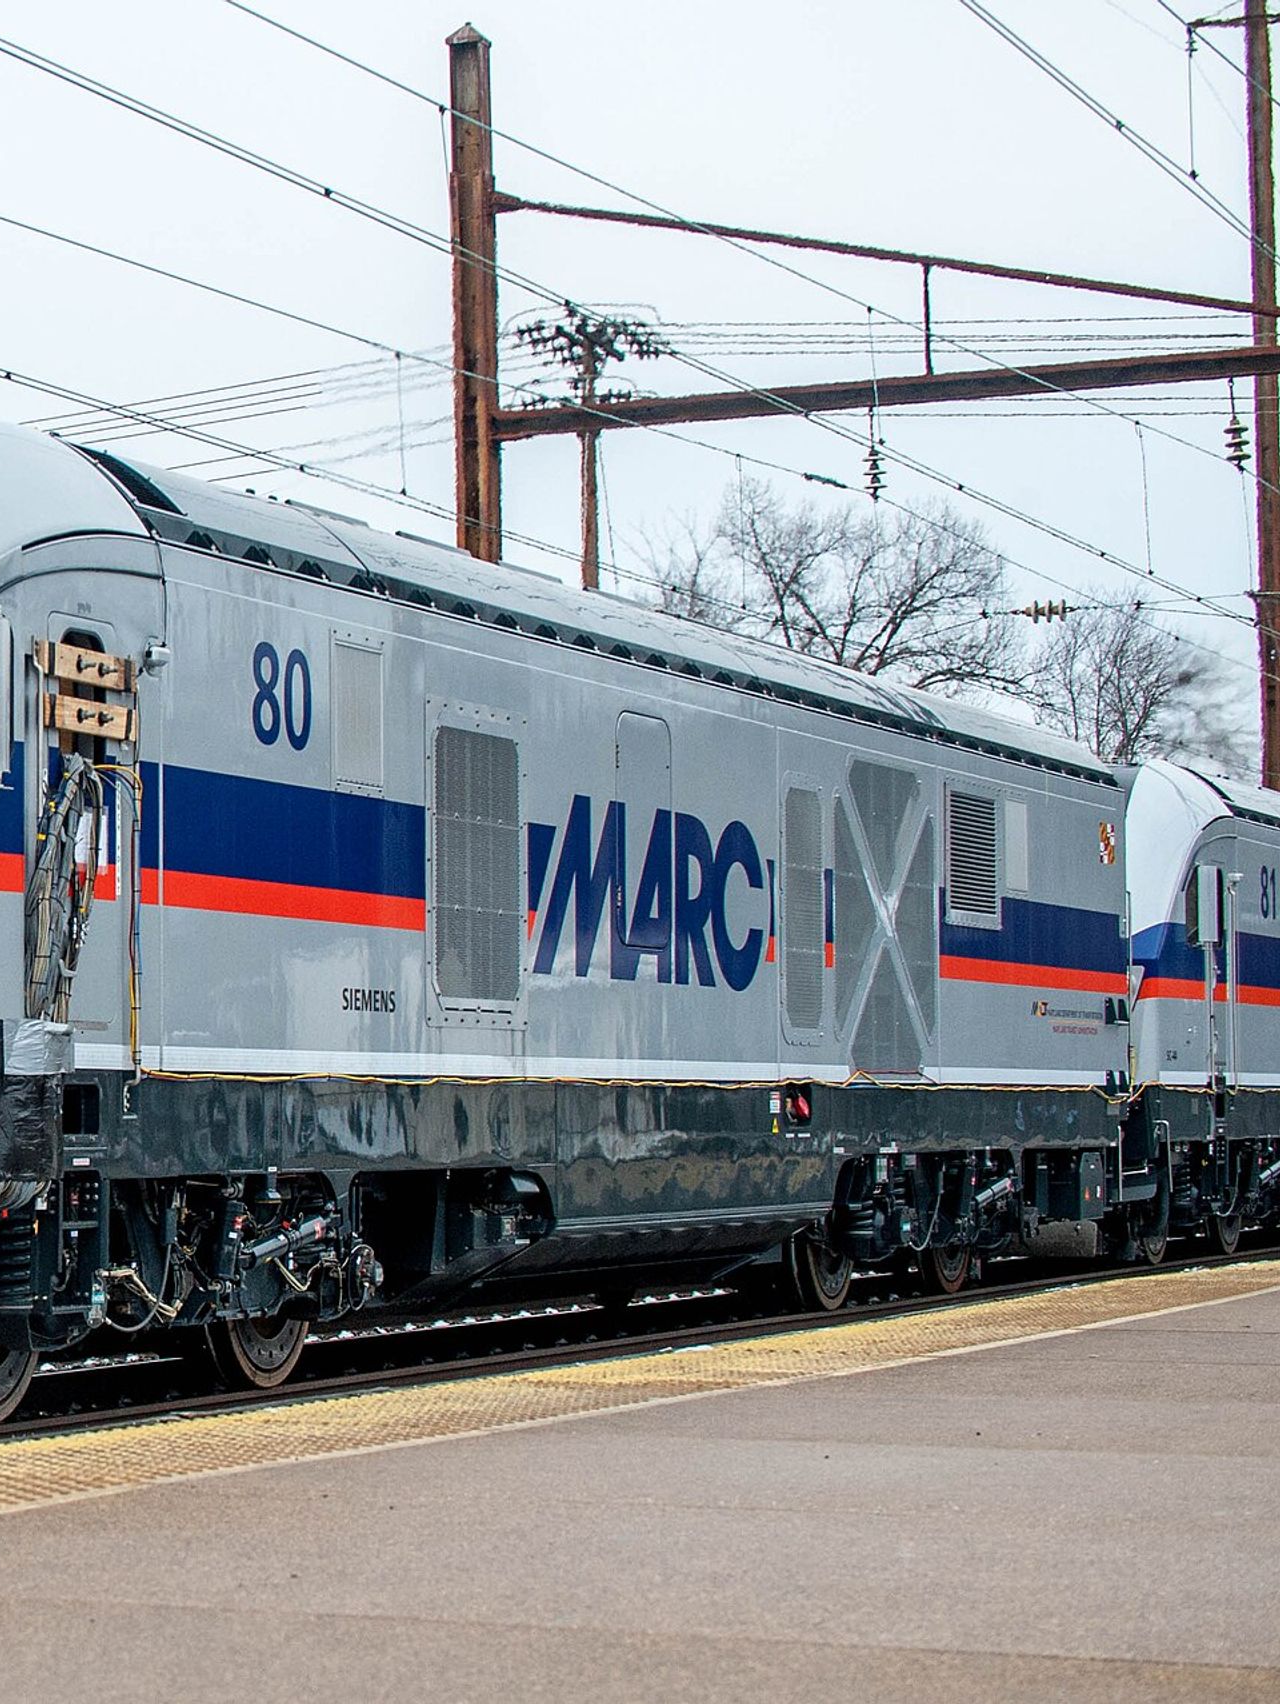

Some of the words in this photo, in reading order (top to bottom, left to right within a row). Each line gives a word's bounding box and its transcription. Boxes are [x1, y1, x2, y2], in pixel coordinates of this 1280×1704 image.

[252, 641, 312, 751] 80
[532, 794, 764, 991] MARC
[1261, 865, 1276, 919] 81
[342, 988, 396, 1012] SIEMENS
